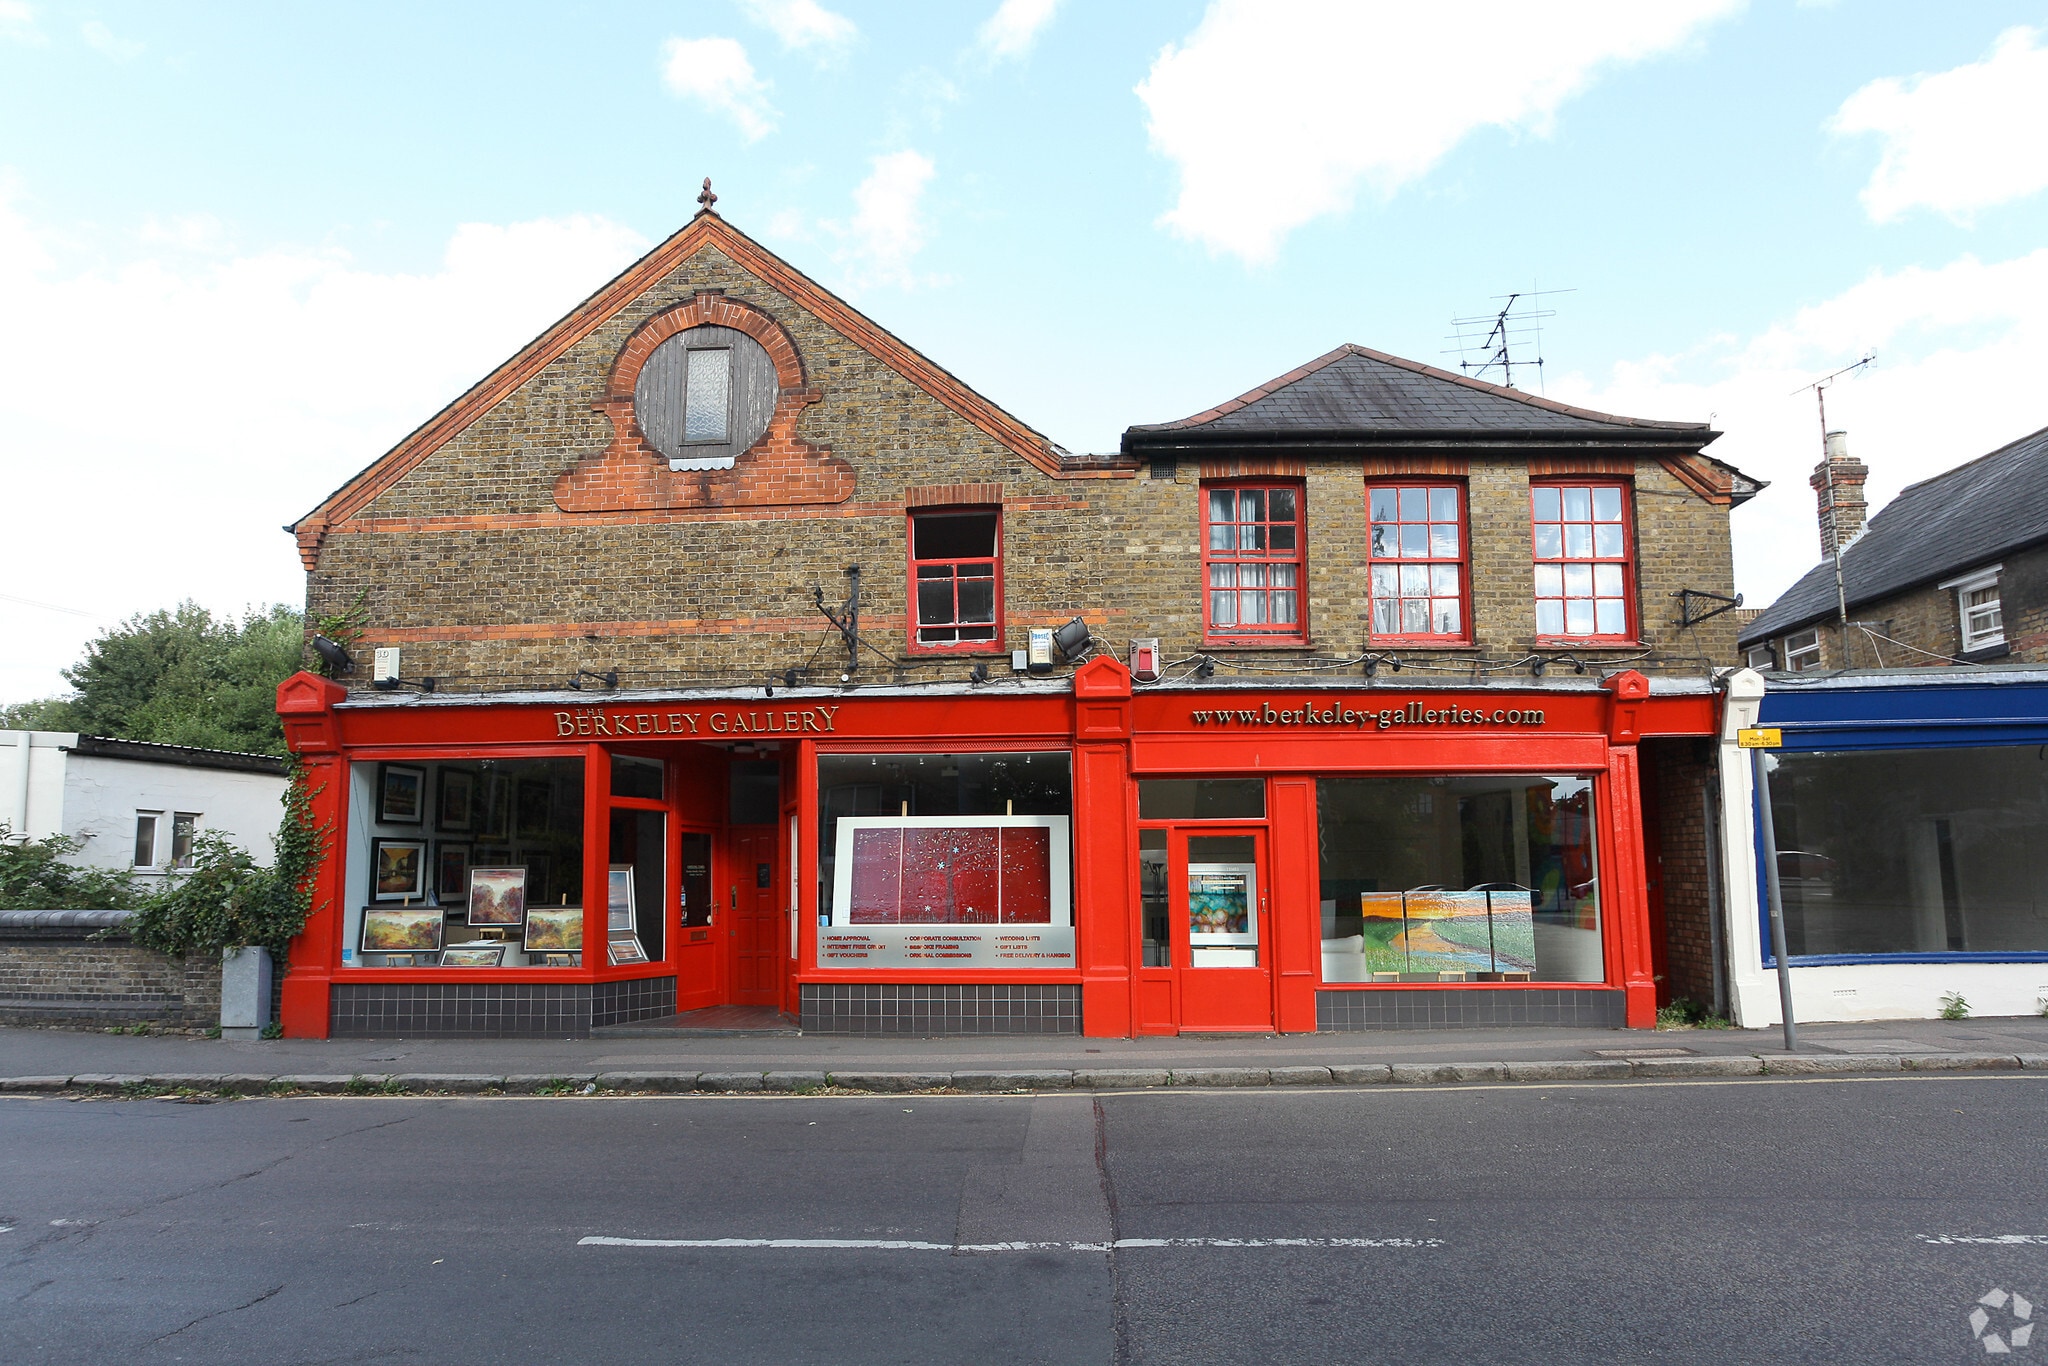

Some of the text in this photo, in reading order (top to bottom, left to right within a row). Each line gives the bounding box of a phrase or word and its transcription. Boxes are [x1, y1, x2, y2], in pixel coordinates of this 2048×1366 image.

[554, 706, 839, 737] BERKELEY GALLERY
[575, 708, 604, 716] THE
[1192, 702, 1545, 728] www.berkeley-galleries.com
